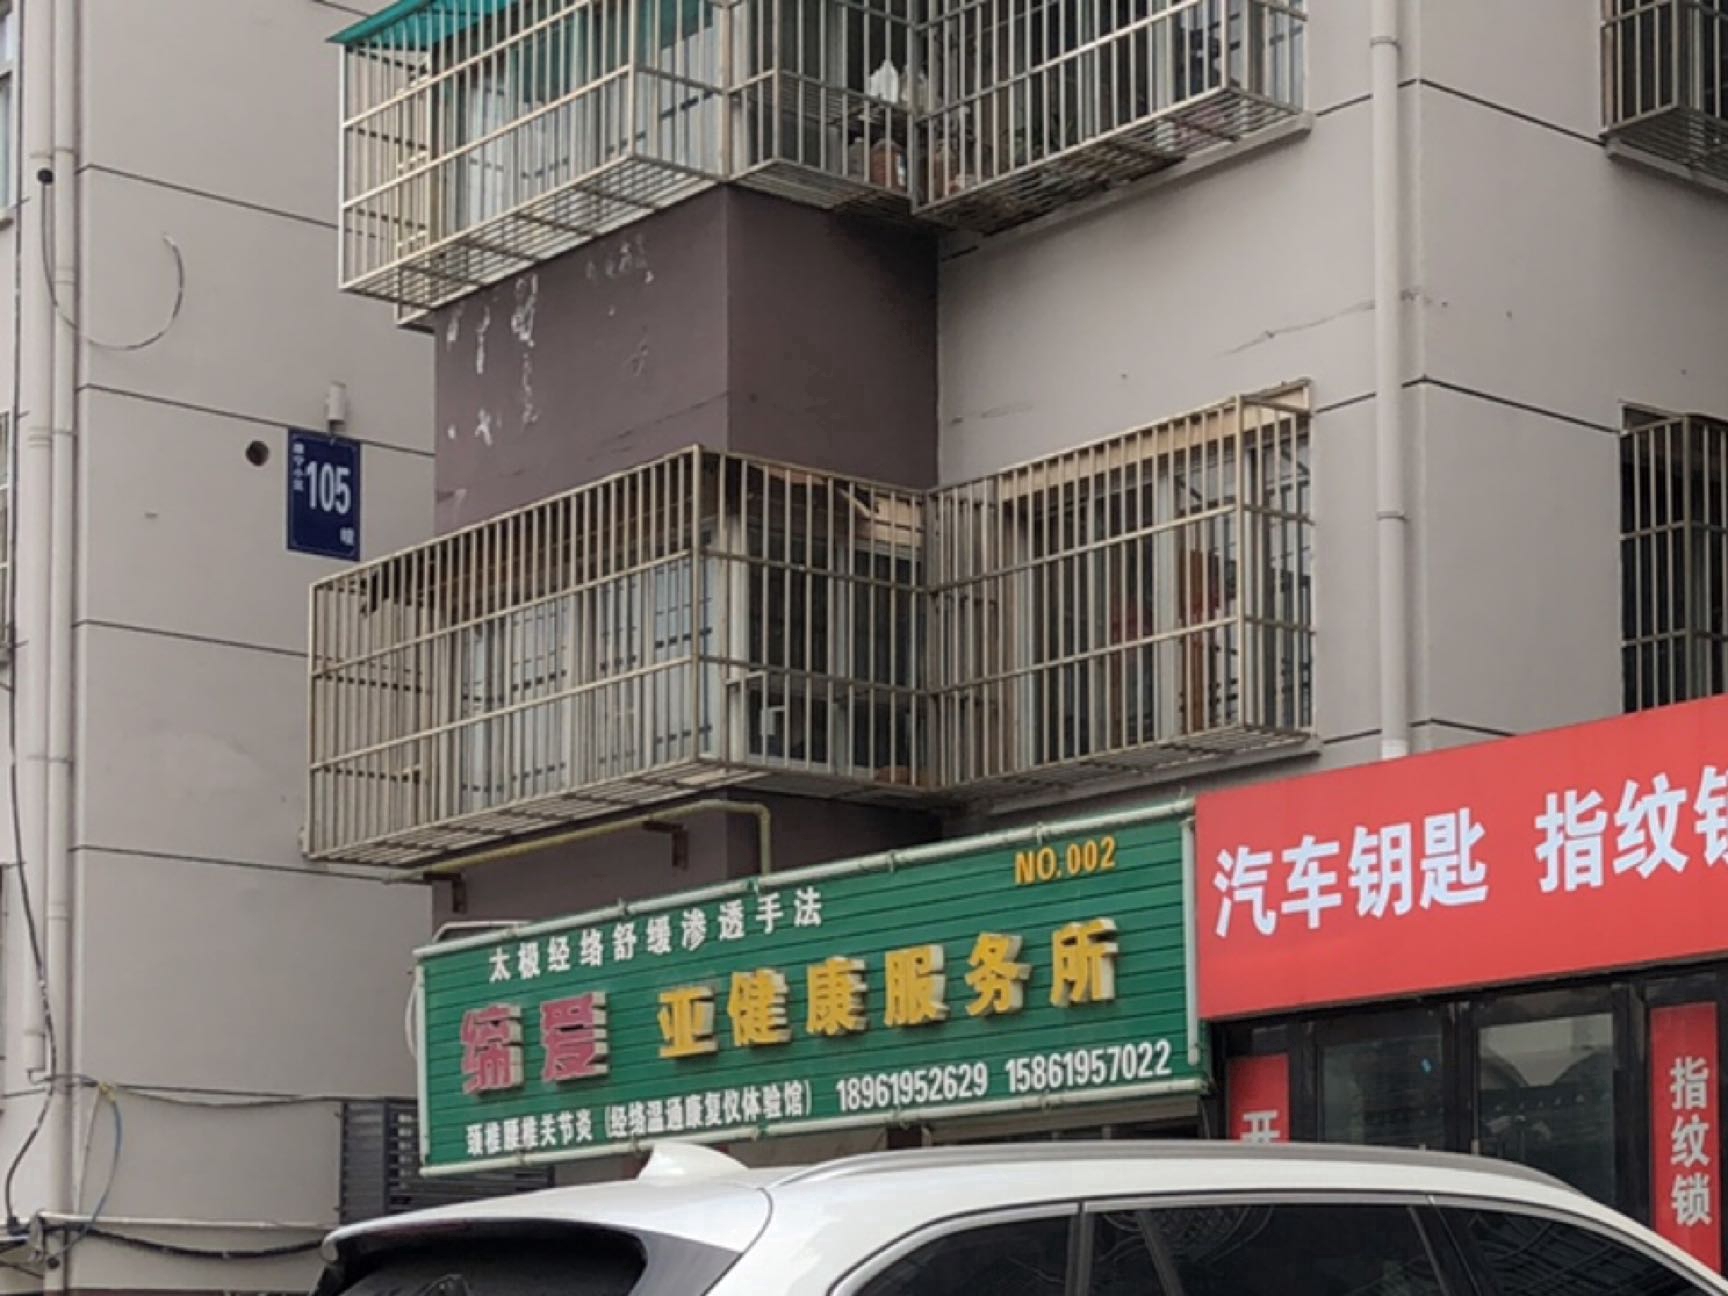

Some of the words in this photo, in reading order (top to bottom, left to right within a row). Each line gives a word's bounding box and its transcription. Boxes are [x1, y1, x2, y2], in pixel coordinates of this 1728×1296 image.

[306, 459, 352, 515] 105
[1015, 835, 1117, 885] NO.002
[1213, 808, 1490, 938] 汽车钥匙
[488, 886, 822, 983] 太极经络舒缓渗透手法
[656, 917, 1118, 1060] 亚健康服务所
[836, 1062, 988, 1112] 18961952629
[1005, 1038, 1172, 1094] 15861957022
[1668, 1056, 1711, 1228] 指纹锁
